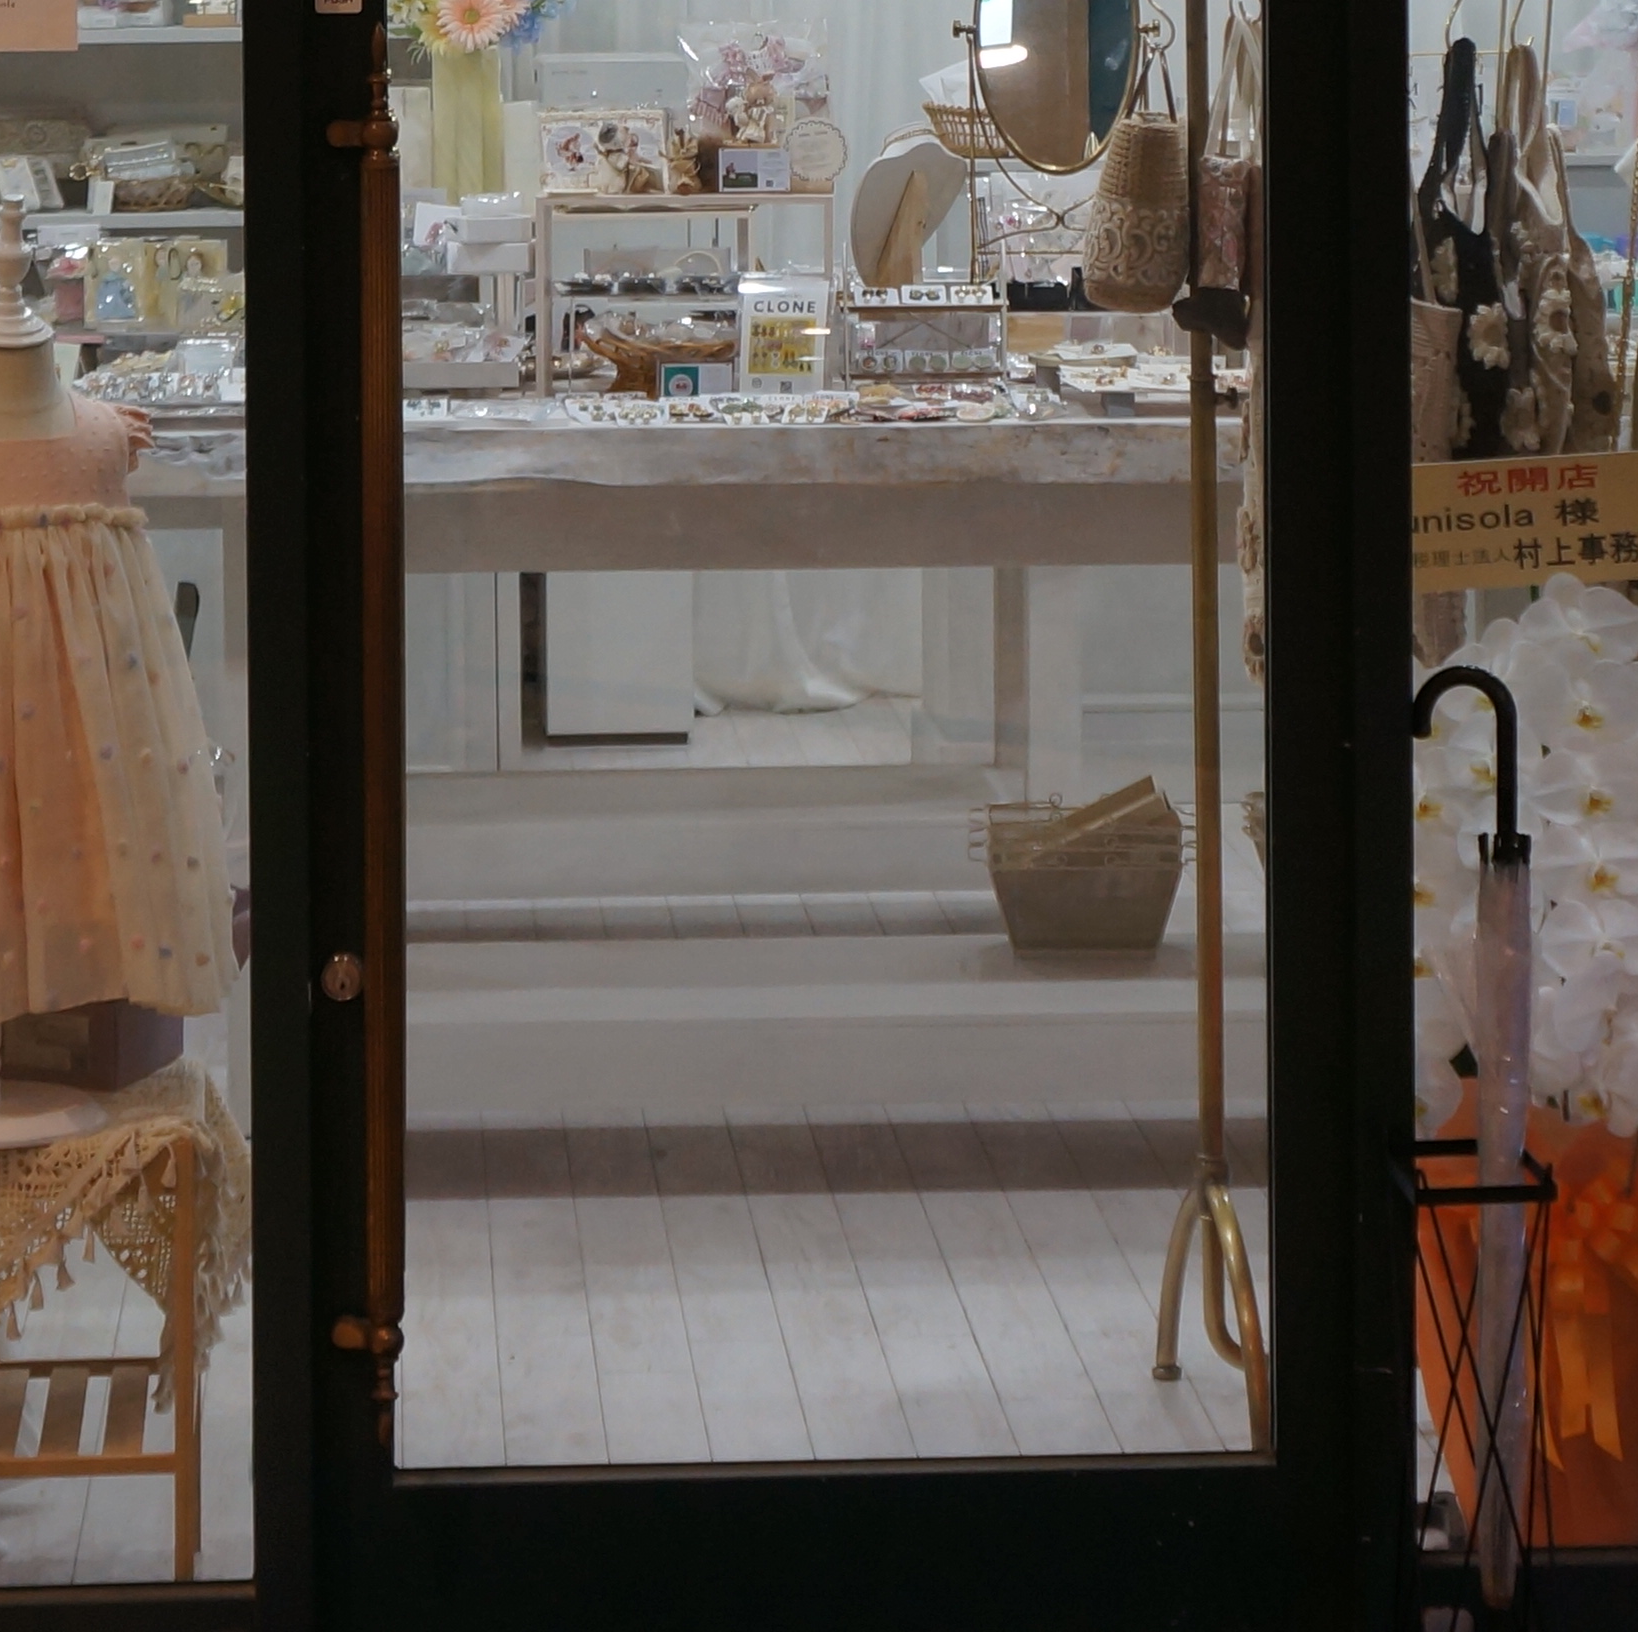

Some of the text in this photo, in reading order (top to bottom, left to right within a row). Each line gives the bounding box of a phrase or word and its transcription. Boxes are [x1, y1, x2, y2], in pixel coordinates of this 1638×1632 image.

[754, 300, 817, 314] CLONE
[1457, 464, 1599, 497] 祝開店
[1554, 497, 1600, 527] 様
